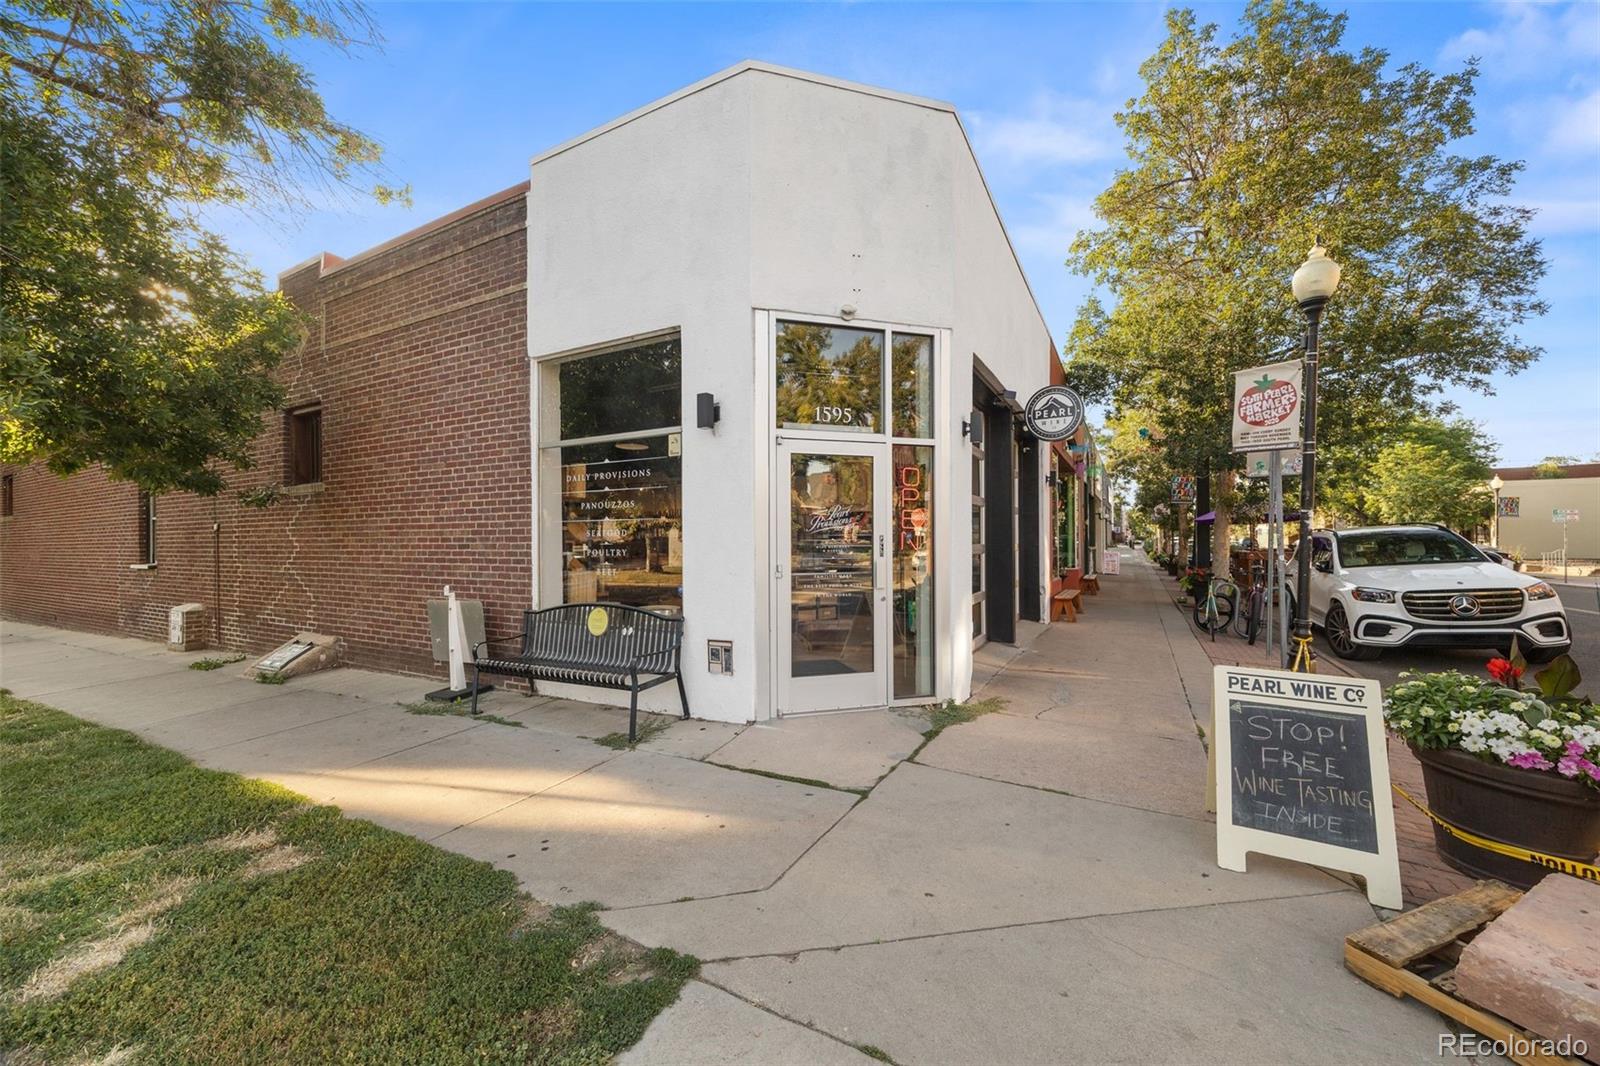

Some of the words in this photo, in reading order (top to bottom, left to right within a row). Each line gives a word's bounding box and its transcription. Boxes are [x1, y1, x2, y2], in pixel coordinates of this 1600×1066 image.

[815, 406, 852, 423] 1595
[1035, 408, 1073, 419] PEARL
[566, 473, 591, 483] DAILY
[594, 468, 652, 480] PROVISIONS
[580, 500, 635, 510] PANOUZZOS
[901, 467, 920, 551] OPEN
[586, 528, 628, 538] SEAFOOD
[586, 548, 628, 557] POULTRY
[1228, 676, 1286, 695] PEARL
[1290, 682, 1337, 701] WINE
[1247, 715, 1348, 750] STOP!
[1261, 746, 1344, 780] FREE
[1234, 767, 1287, 796] WINE
[1288, 777, 1373, 816] TASTING
[1251, 801, 1344, 834] INSIDE
